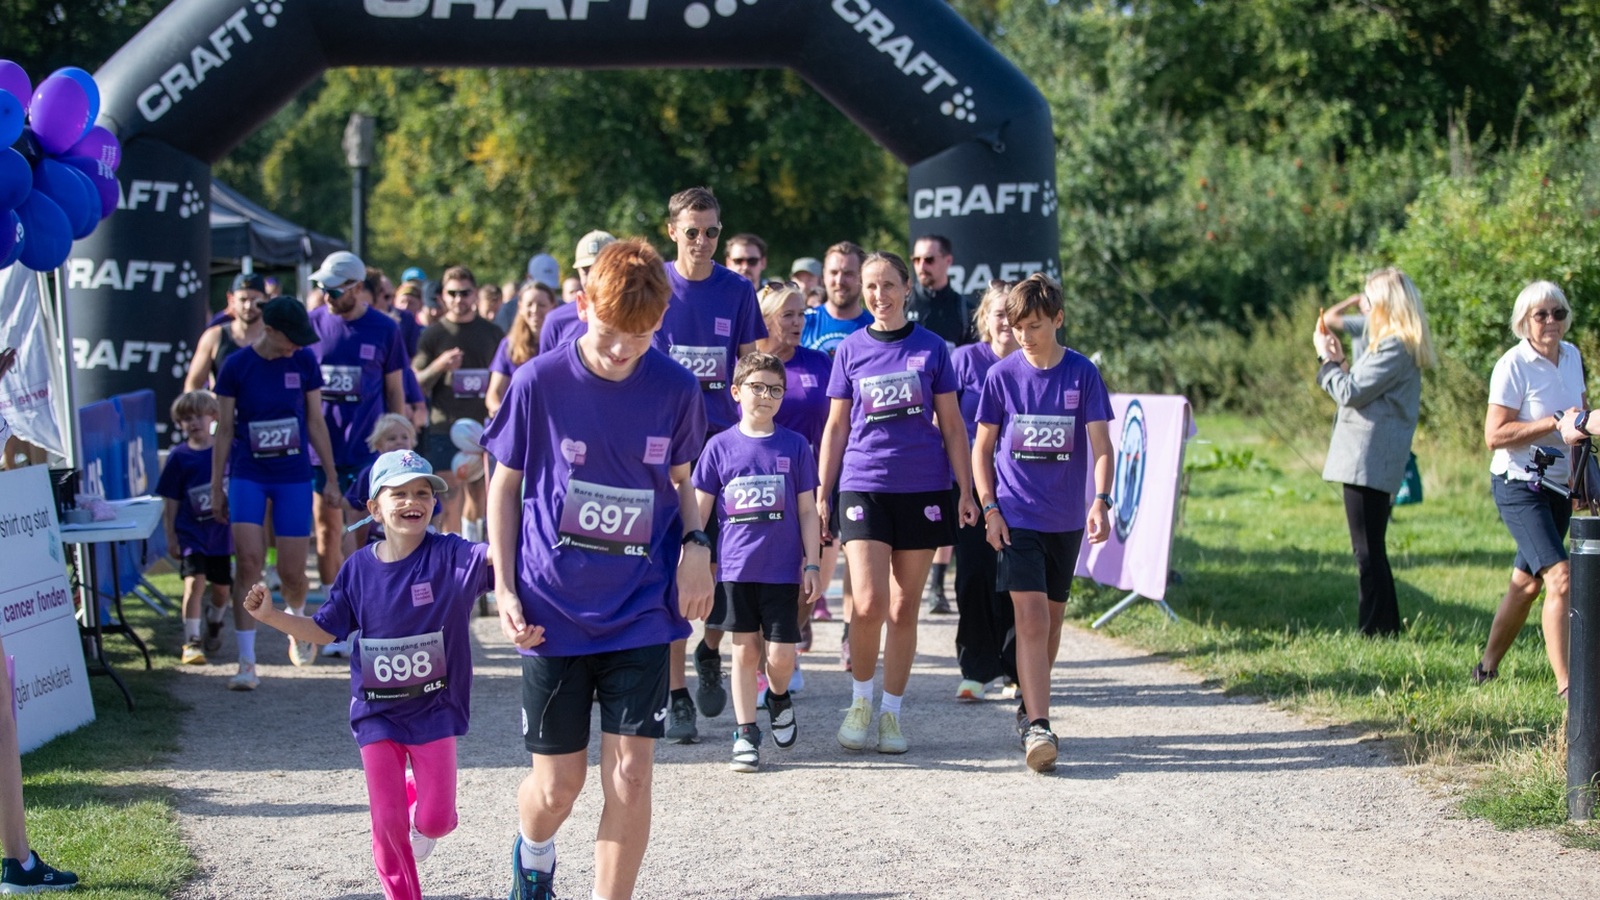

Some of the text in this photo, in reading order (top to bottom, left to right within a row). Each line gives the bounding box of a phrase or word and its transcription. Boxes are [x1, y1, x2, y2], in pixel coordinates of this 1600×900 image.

[830, 0, 958, 94] CRAFT
[137, 6, 253, 122] CRAFT
[913, 182, 1038, 219] CRAFT
[68, 258, 176, 292] RAFT
[946, 262, 1043, 295] RAFT
[72, 337, 172, 373] RAFT
[870, 382, 912, 408] 224
[258, 428, 292, 448] 227
[1023, 426, 1066, 448] 223
[734, 487, 776, 510] 225
[579, 501, 642, 536] 697
[3, 586, 68, 623] cancer fonden
[390, 642, 419, 652] omgang
[374, 650, 433, 683] 698
